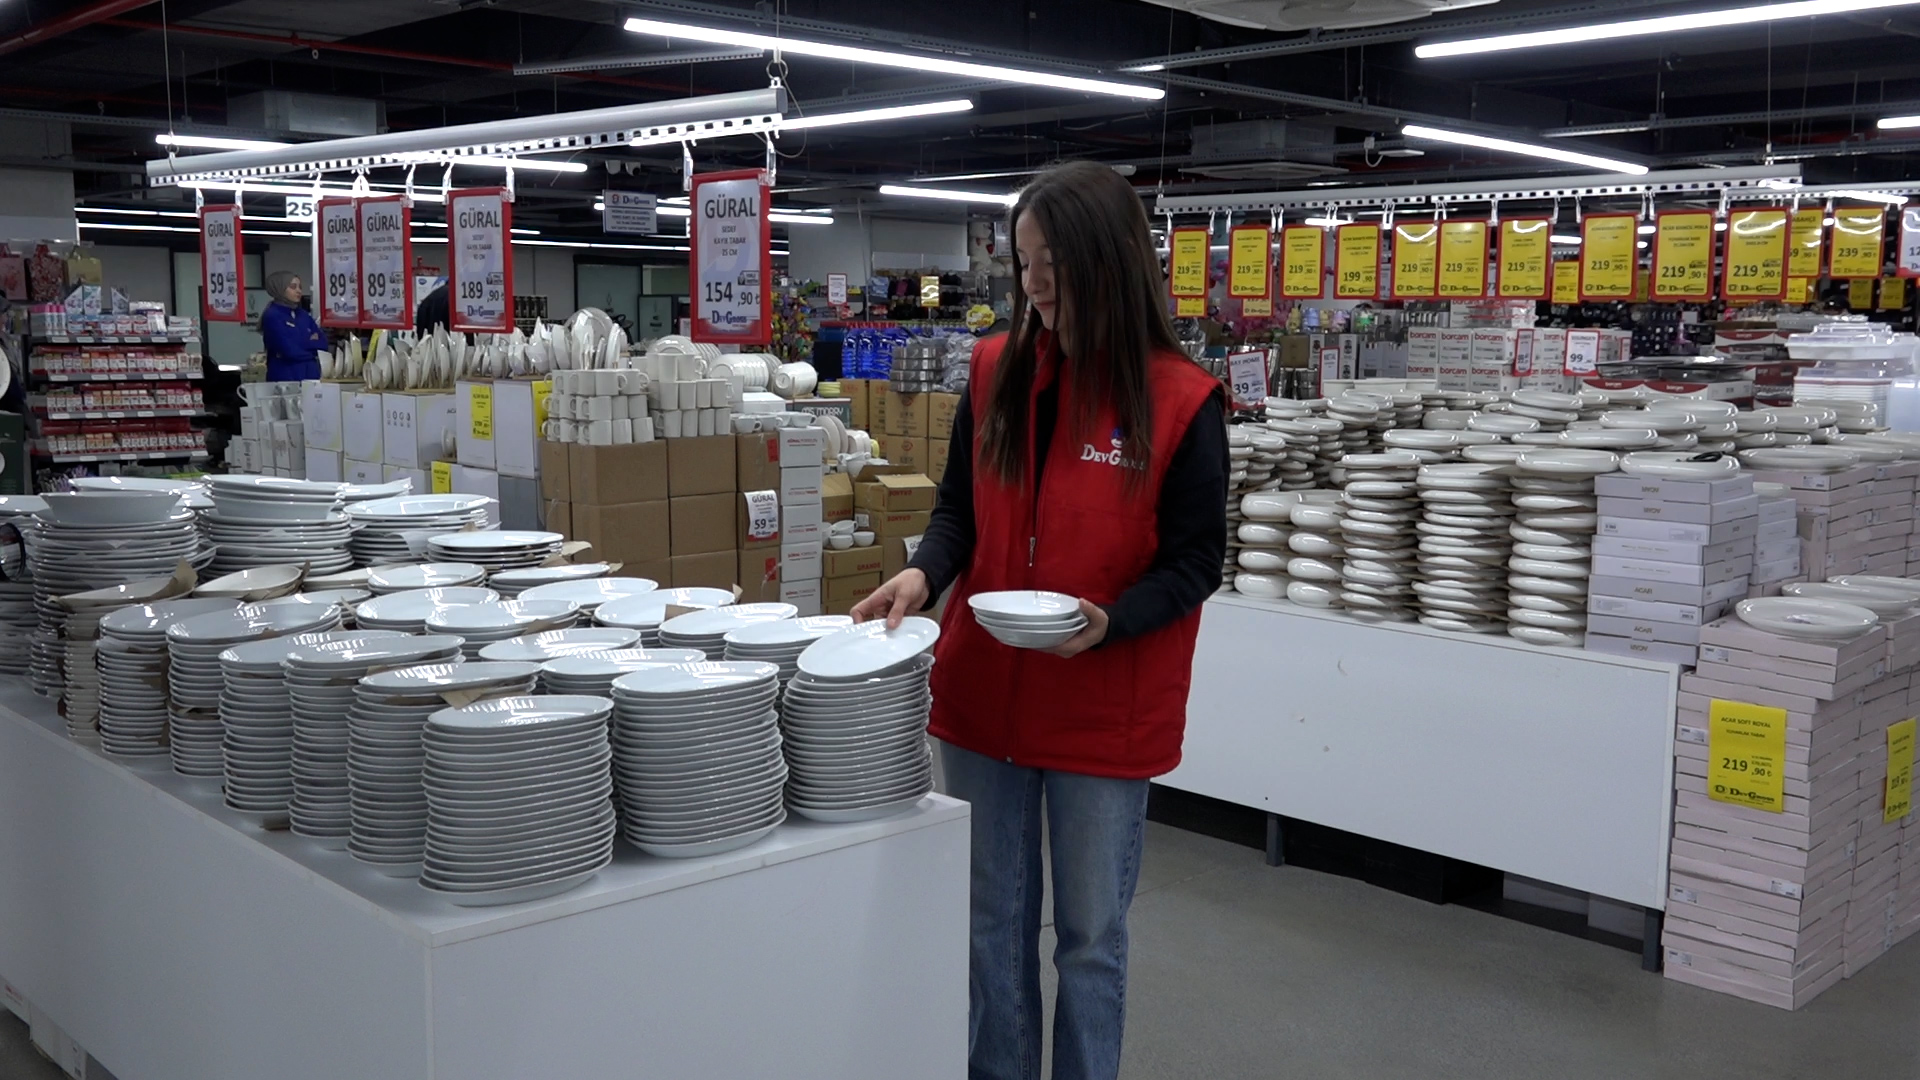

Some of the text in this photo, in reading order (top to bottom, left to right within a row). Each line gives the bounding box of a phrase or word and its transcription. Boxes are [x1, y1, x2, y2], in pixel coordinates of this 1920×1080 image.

[287, 202, 313, 216] 25
[705, 194, 756, 219] GÜRAL
[366, 212, 400, 232] GÜRAL
[459, 208, 500, 229] GÜRAL
[208, 220, 233, 238] GÜRAL
[327, 215, 356, 234] GÜRA
[1838, 248, 1858, 257] 239
[1237, 265, 1251, 274] 219
[1289, 265, 1303, 274] 219
[1402, 264, 1418, 273] 219
[1446, 263, 1463, 272] 219
[1507, 262, 1525, 272] 219
[1591, 261, 1610, 270] 219
[1733, 265, 1758, 277] 219
[1344, 272, 1361, 282] 199
[1662, 266, 1686, 278] 219
[210, 273, 224, 294] 59
[330, 273, 346, 297] 89
[368, 273, 386, 297] 89
[461, 281, 499, 303] 189 ,90
[705, 281, 733, 303] 154
[738, 291, 753, 307] ,90
[1474, 333, 1503, 341] borcam
[1570, 353, 1583, 362] 99
[1408, 365, 1435, 373] borcam
[1440, 366, 1467, 375] borcam
[1472, 366, 1499, 375] borcam
[1234, 382, 1249, 394] 39
[752, 494, 774, 503] GÜRAL
[754, 519, 766, 529] 59
[1722, 757, 1748, 772] 219
[1751, 768, 1765, 776] ,90
